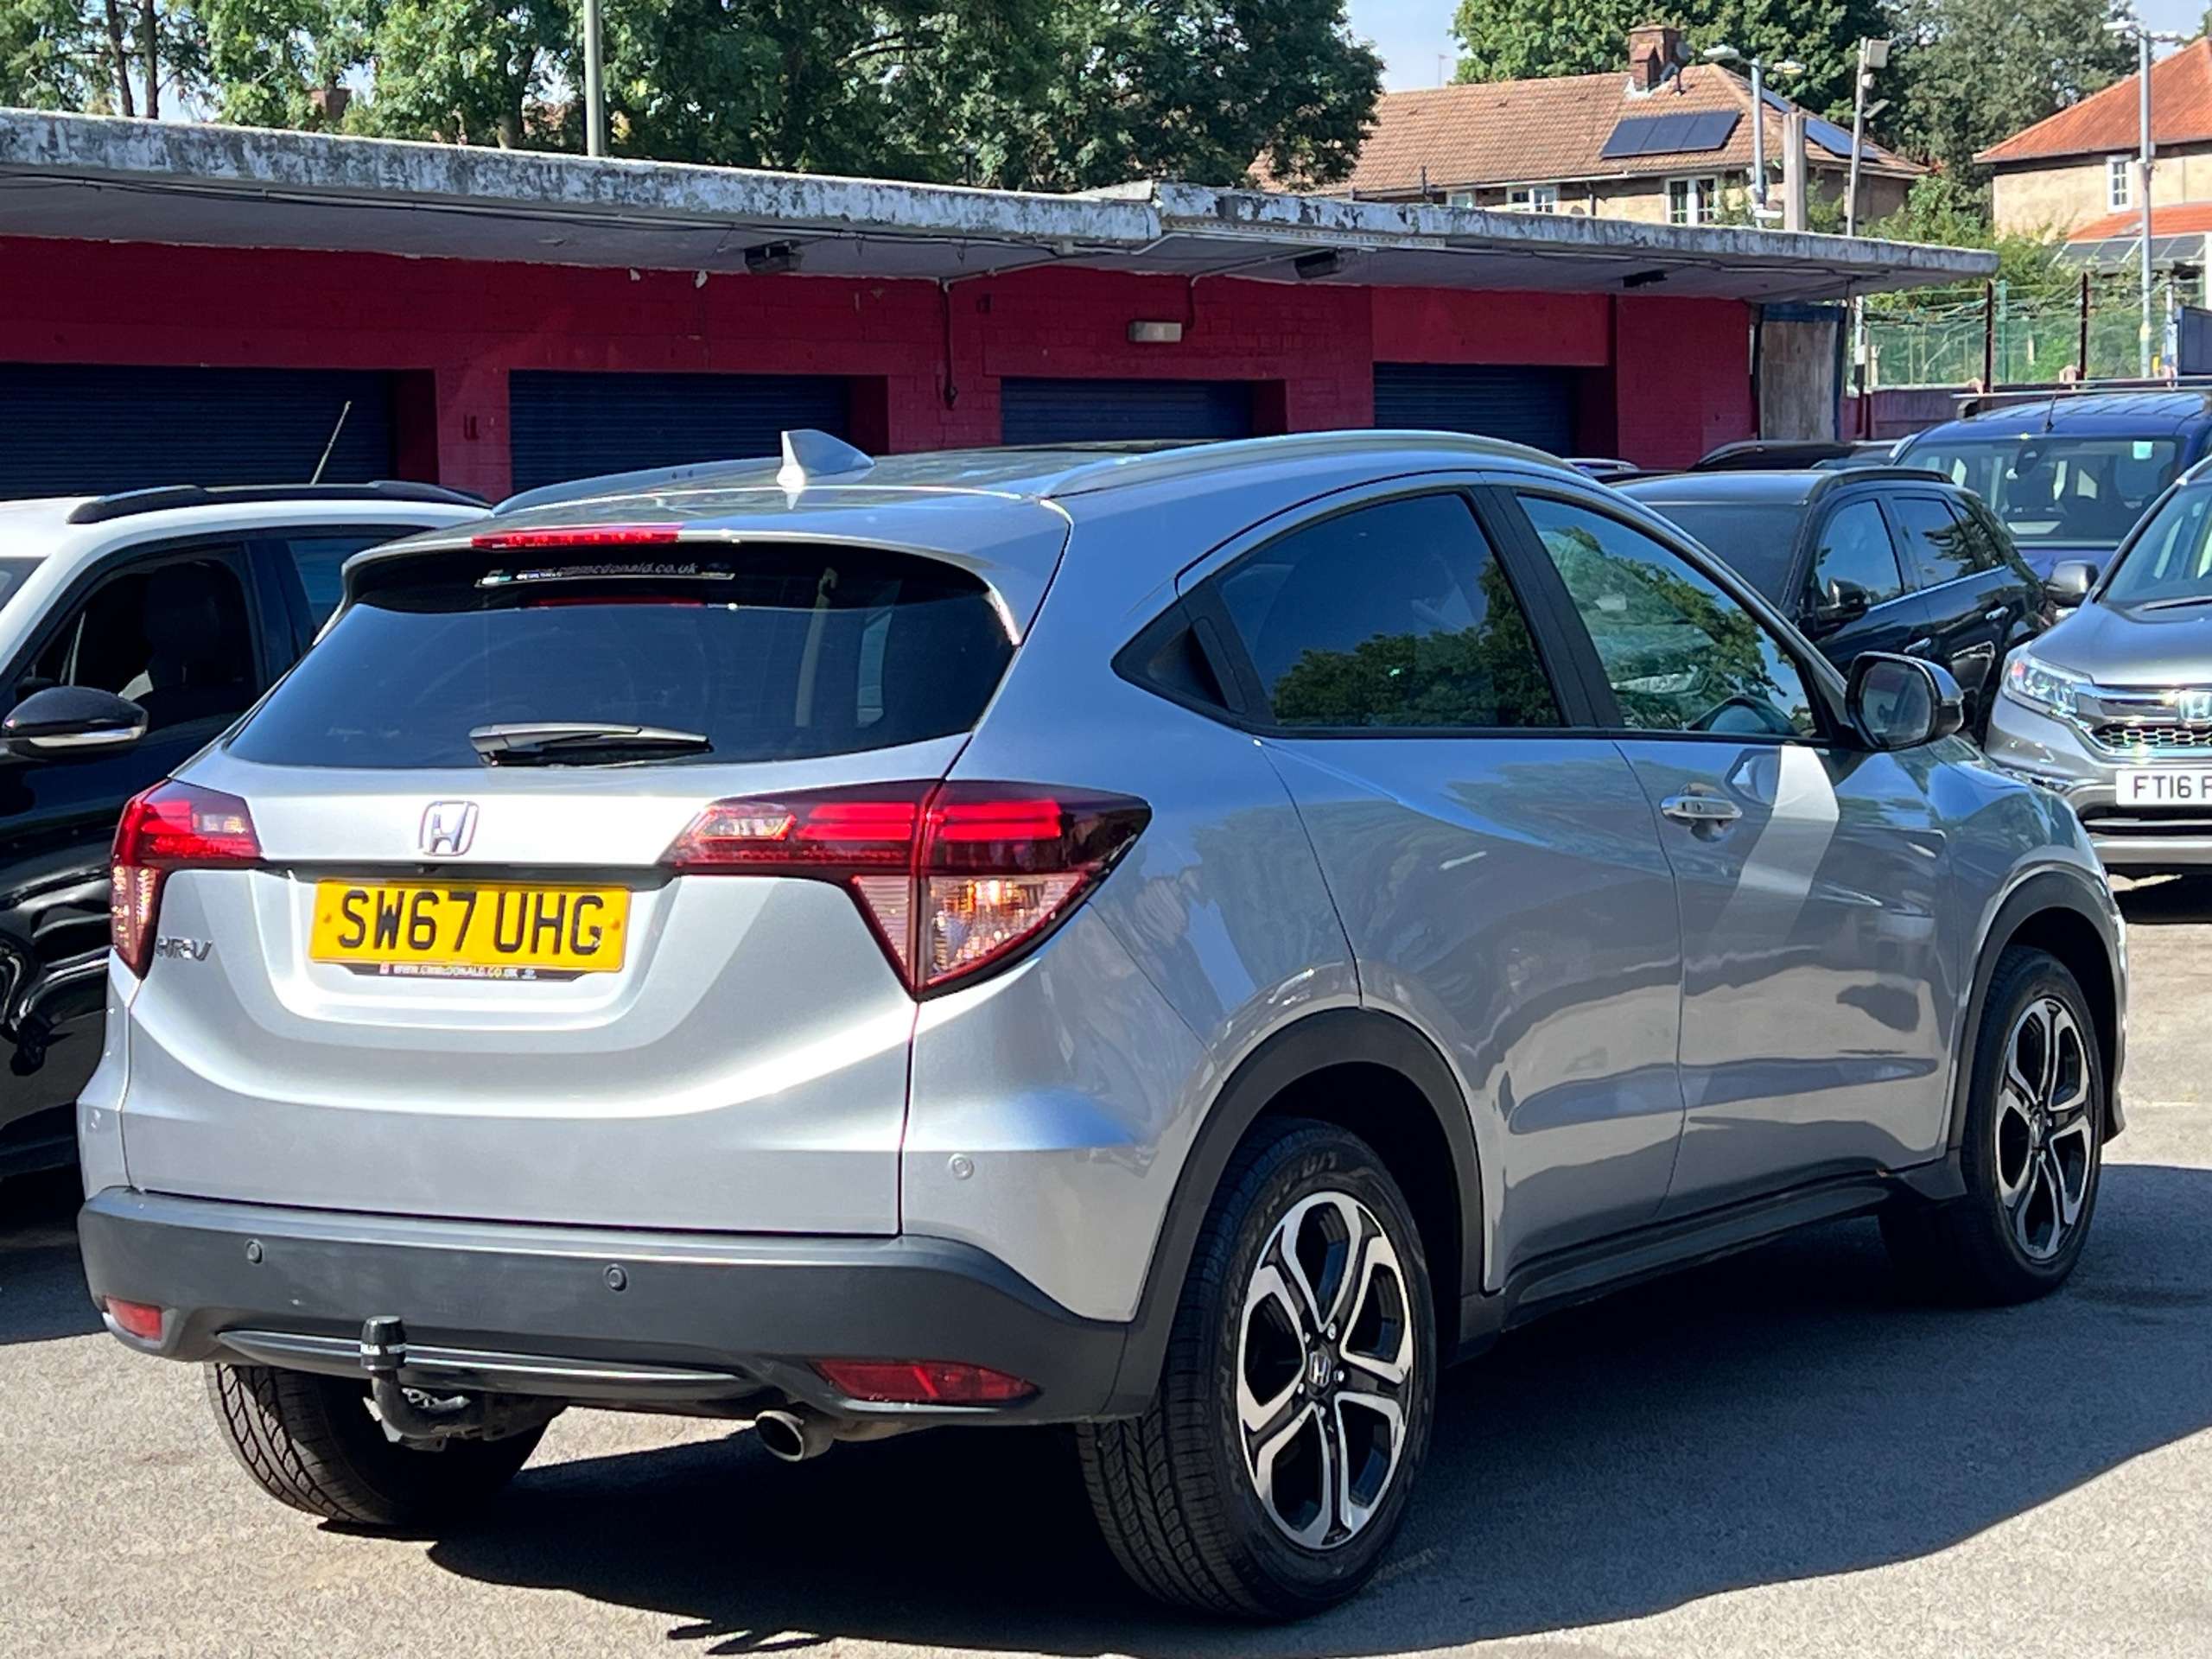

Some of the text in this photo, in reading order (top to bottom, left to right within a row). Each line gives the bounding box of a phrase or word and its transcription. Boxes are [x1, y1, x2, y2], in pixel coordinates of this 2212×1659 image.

[2133, 776, 2192, 799] FT16
[338, 889, 604, 956] SW67 UHG
